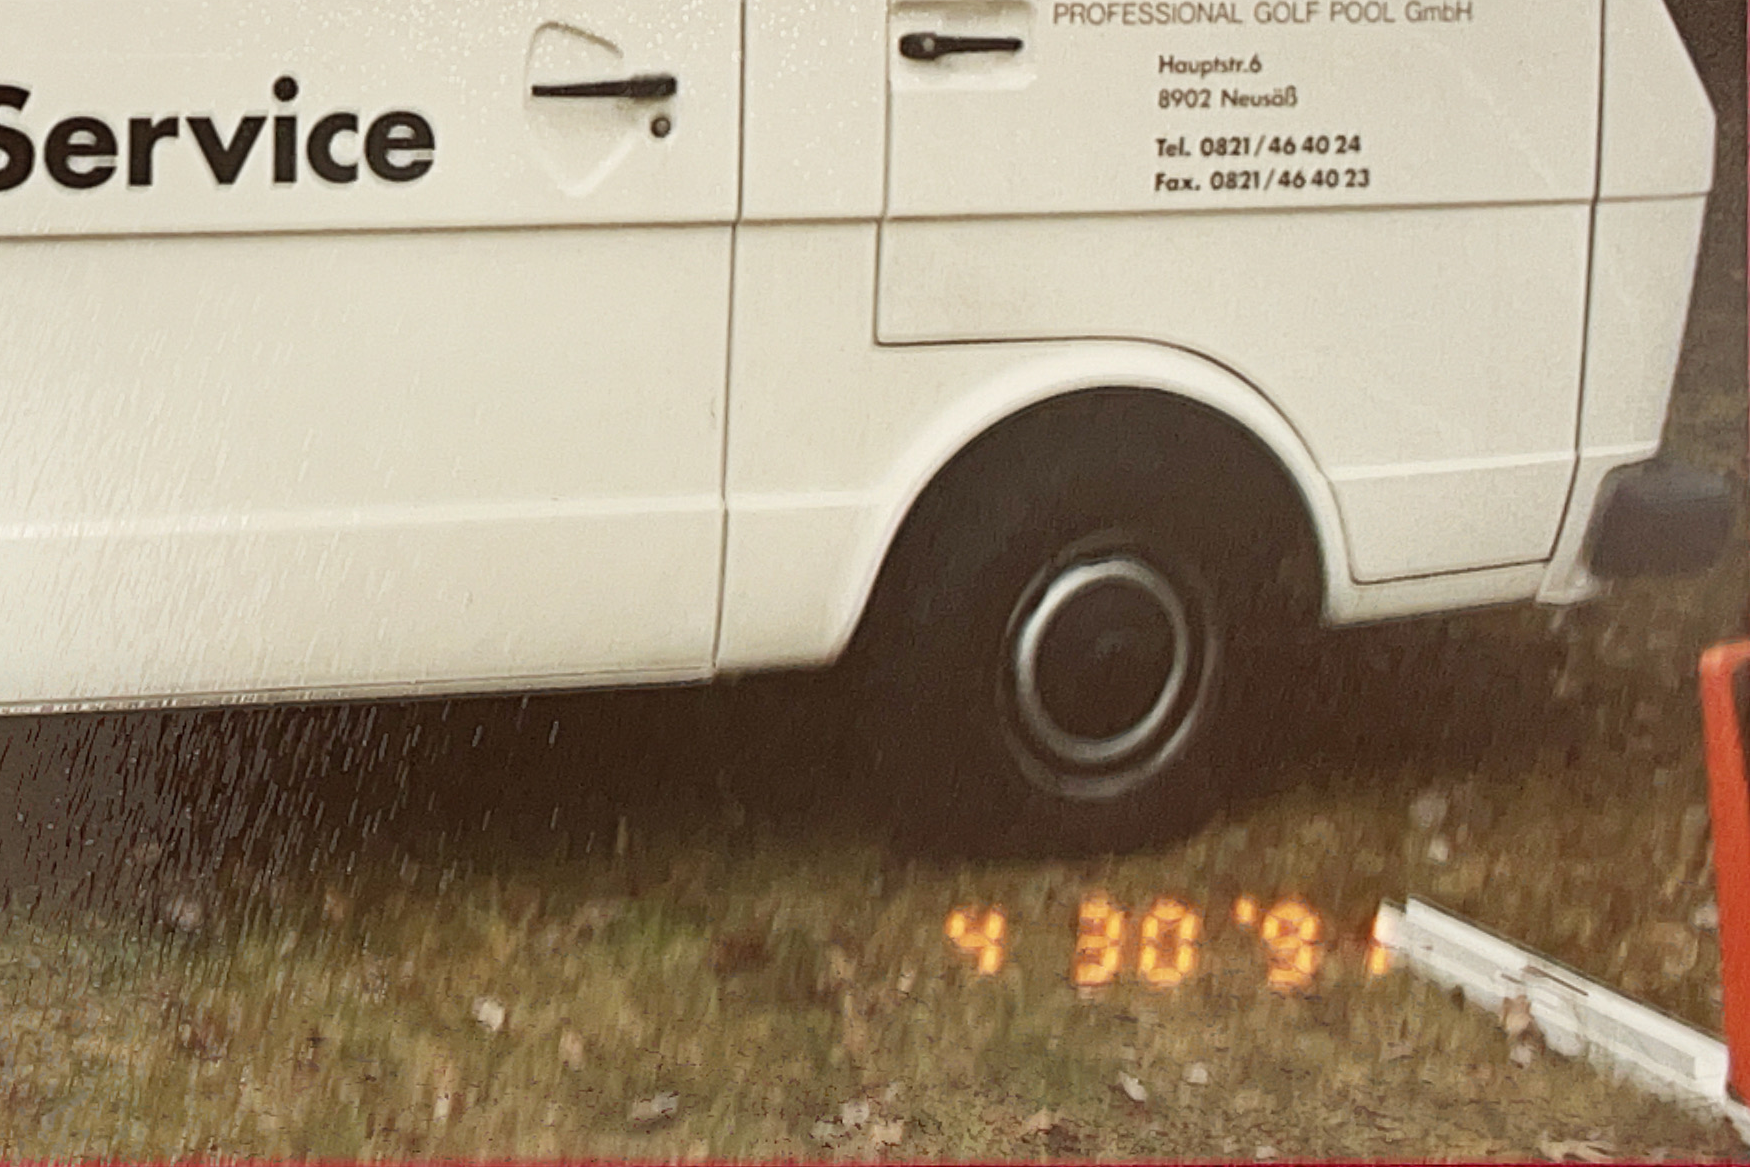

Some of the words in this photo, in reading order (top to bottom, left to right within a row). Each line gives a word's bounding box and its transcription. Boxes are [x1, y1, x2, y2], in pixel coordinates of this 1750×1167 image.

[1053, 1, 1243, 25] PROFESSIONAL
[1254, 1, 1320, 24] GOLF
[1330, 0, 1395, 23] POOL
[1405, 0, 1474, 23] GmbH
[1158, 89, 1212, 109] 8902
[1221, 86, 1298, 109] Neusäß
[1155, 137, 1191, 157] Tel.
[1154, 172, 1200, 191] Fax.
